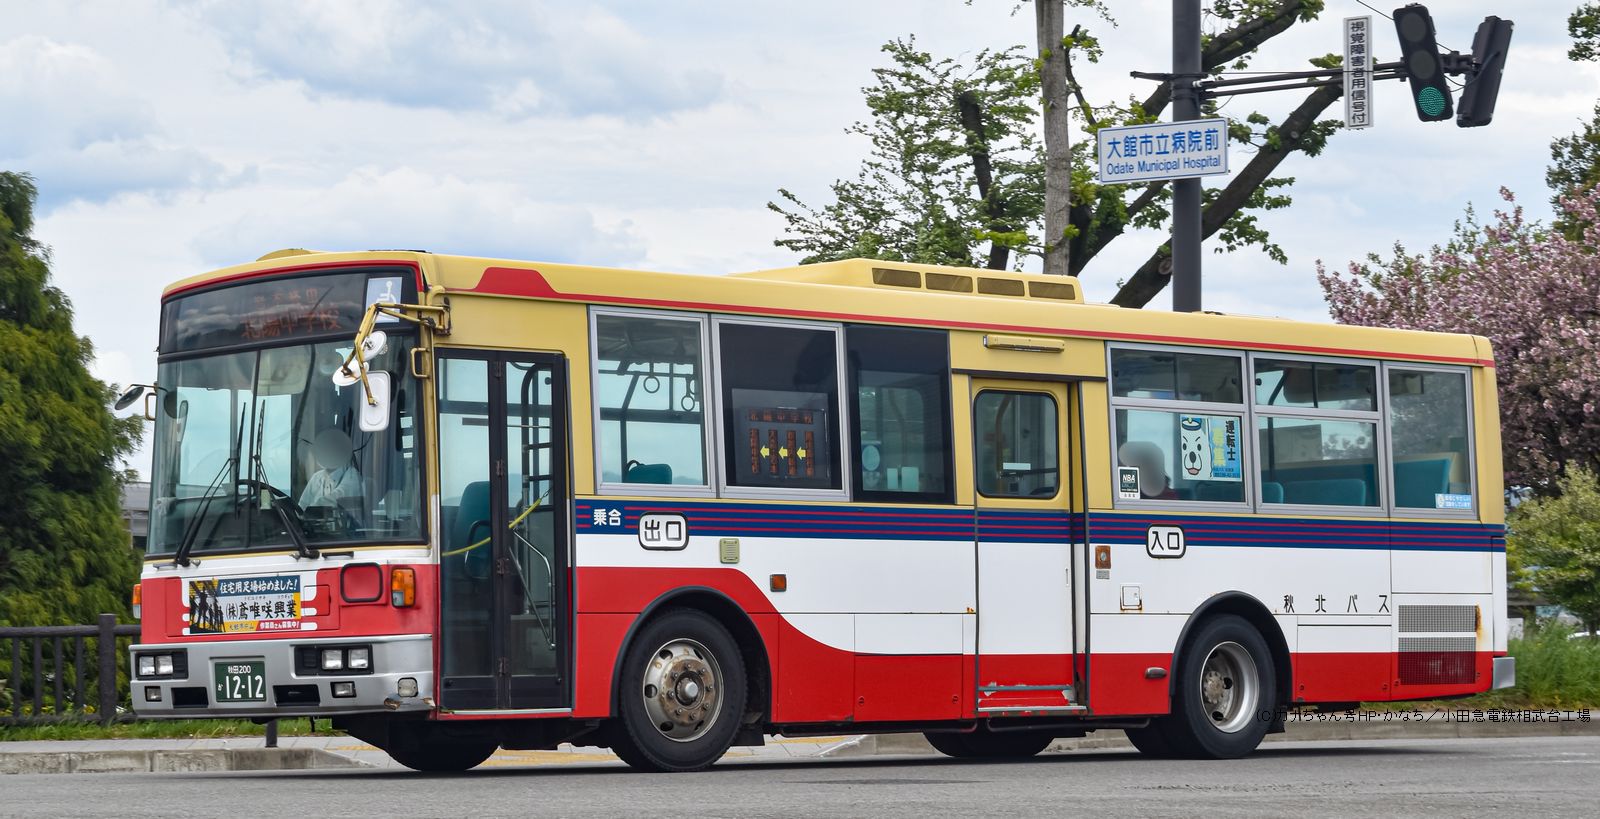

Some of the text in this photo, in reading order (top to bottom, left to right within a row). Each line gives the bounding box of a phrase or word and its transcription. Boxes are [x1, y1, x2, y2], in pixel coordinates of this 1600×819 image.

[1351, 21, 1366, 125] 視覚障害者用信号付
[1106, 128, 1220, 160] 大館市立病院前
[1106, 154, 1221, 176] Odate Municipal Hospital
[1225, 420, 1236, 461] 運転士
[593, 508, 622, 526] 乗合
[644, 519, 682, 542] 出口
[1151, 530, 1181, 552] 入口
